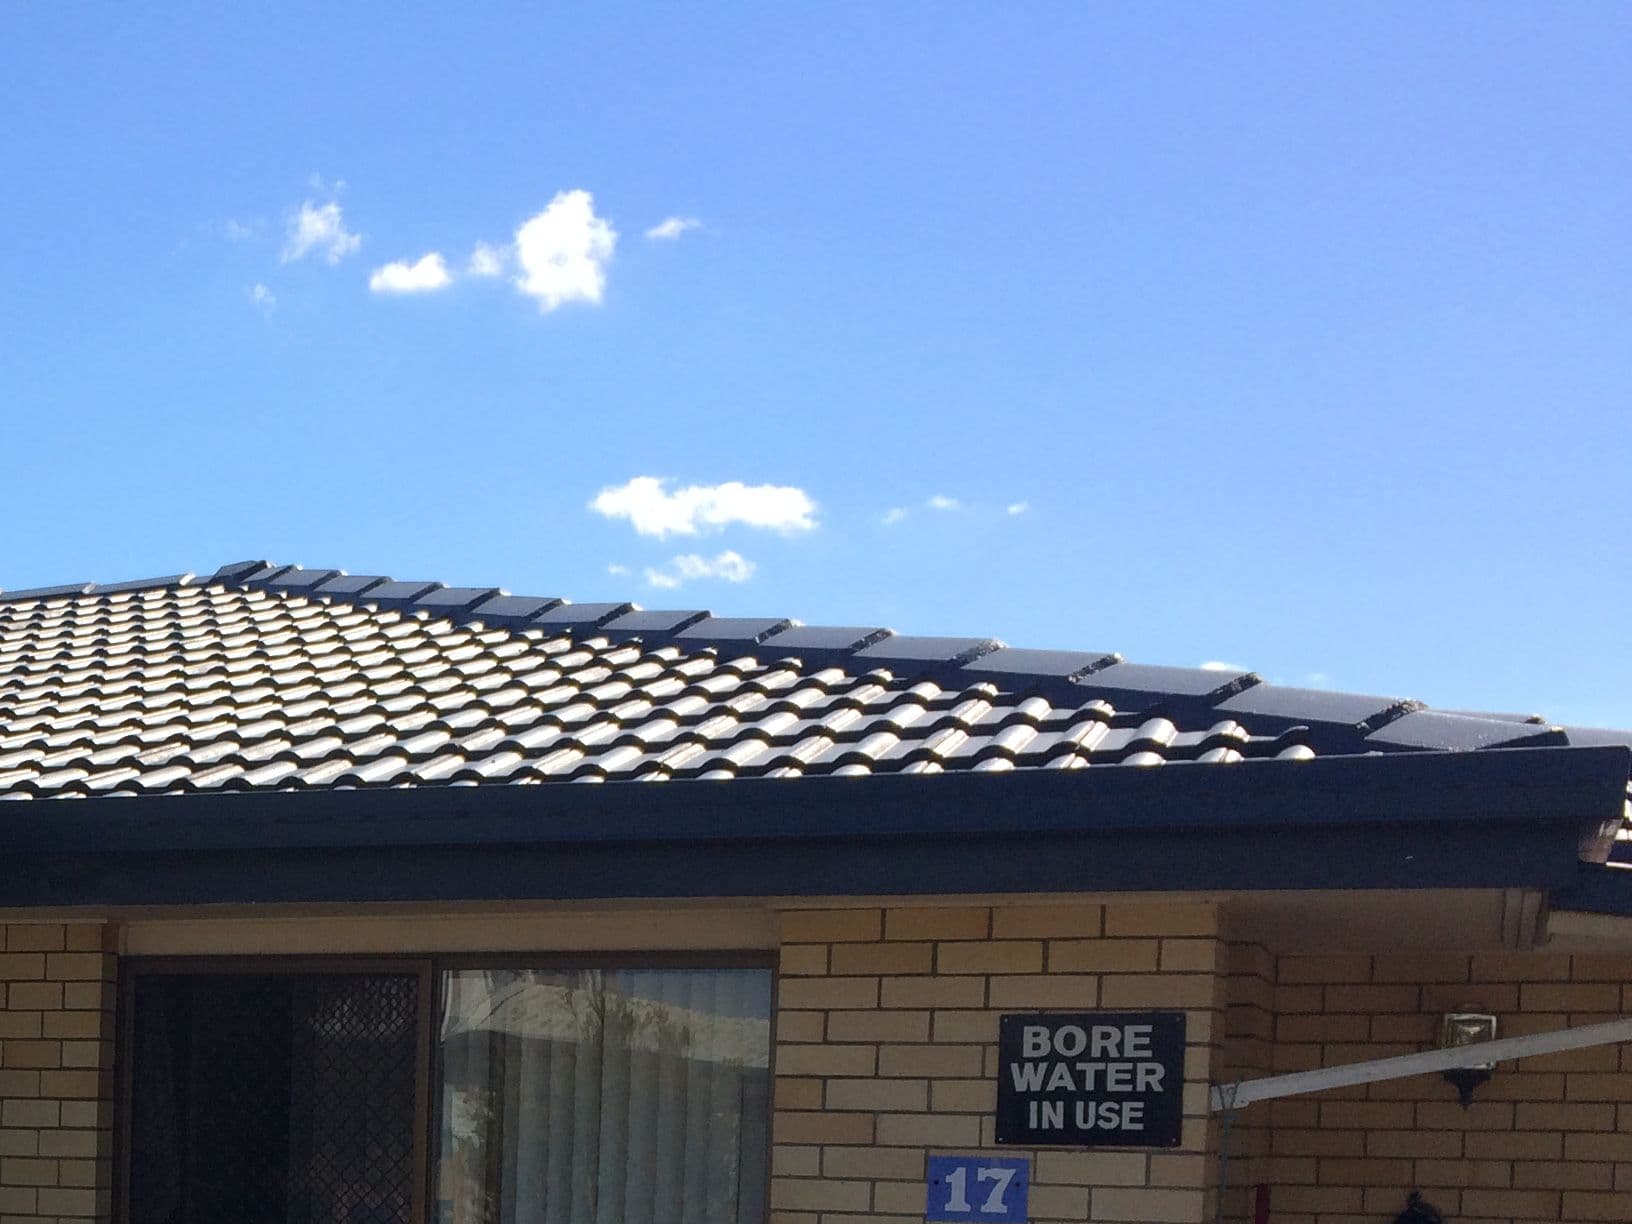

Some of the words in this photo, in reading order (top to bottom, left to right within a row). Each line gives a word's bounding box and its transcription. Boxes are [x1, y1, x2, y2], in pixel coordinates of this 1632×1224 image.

[1022, 1025, 1153, 1058] BORE
[1010, 1062, 1166, 1092] WATER
[1028, 1100, 1064, 1130] IN
[1075, 1101, 1145, 1131] USE
[944, 1167, 1016, 1214] 17
